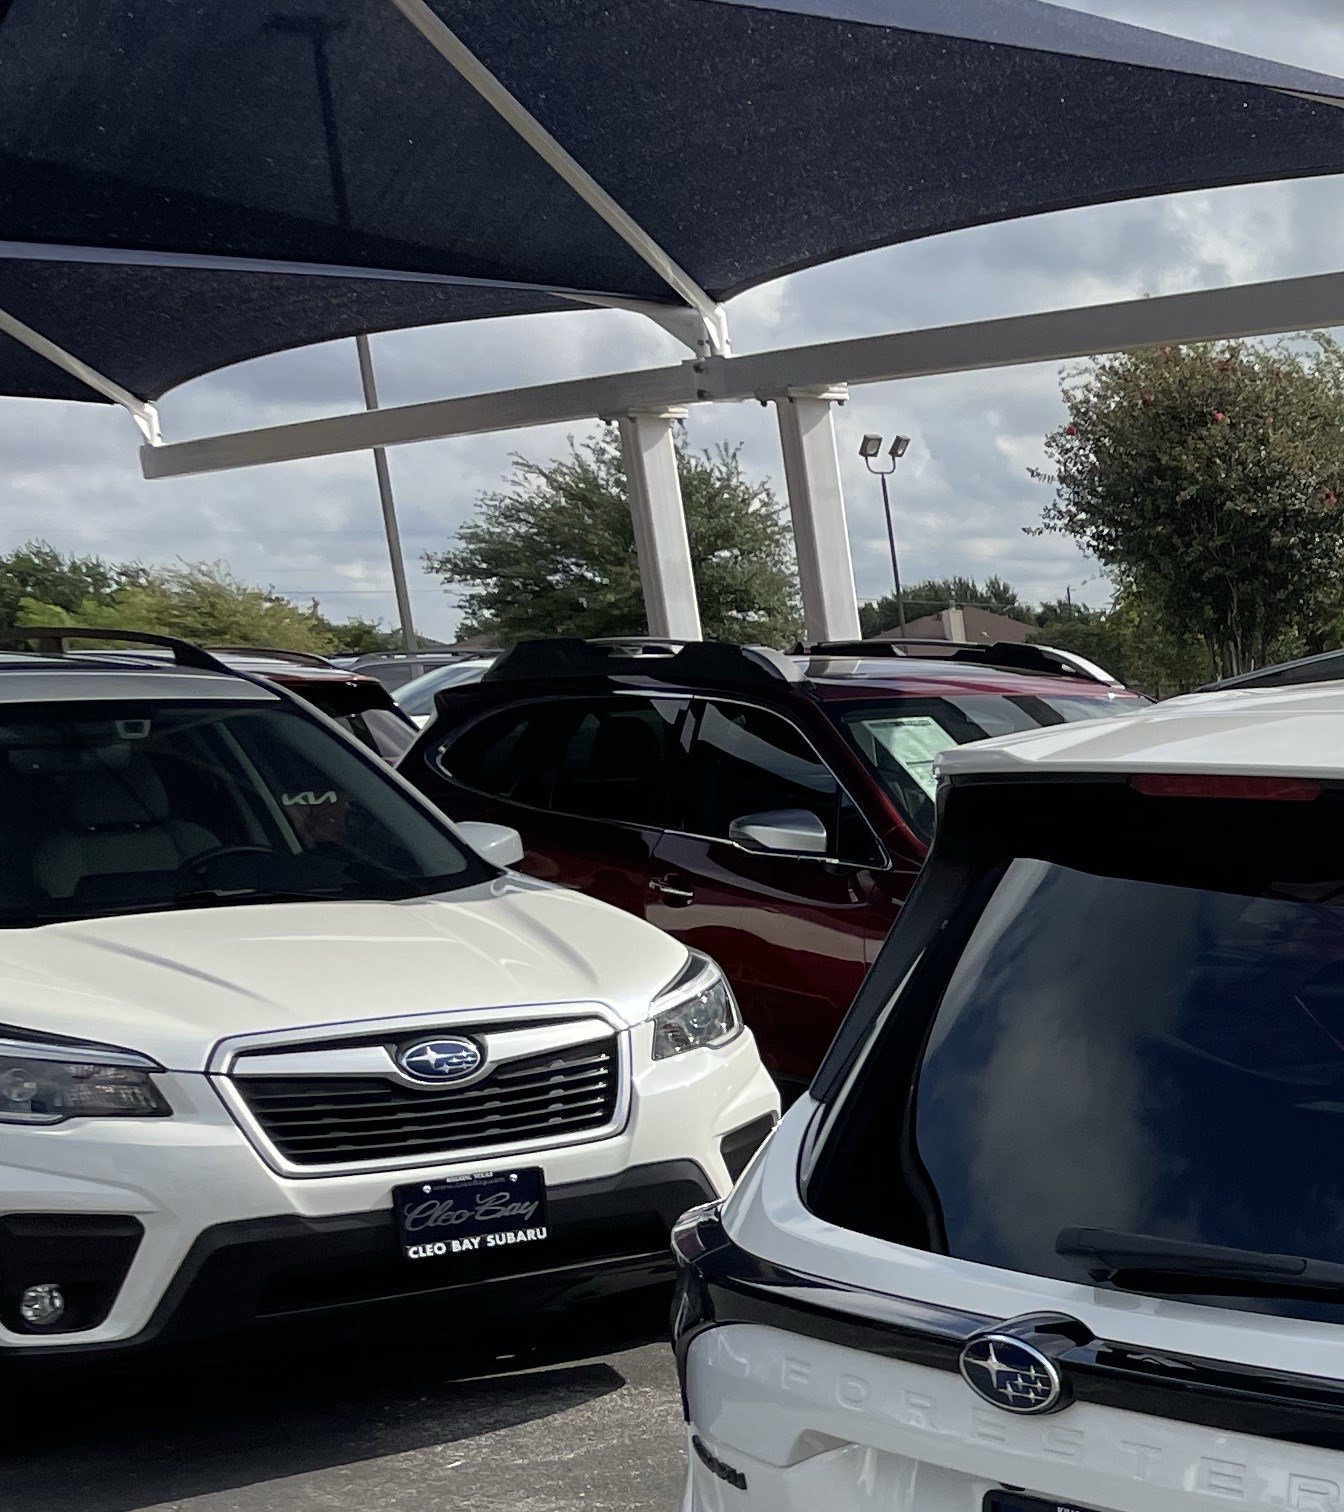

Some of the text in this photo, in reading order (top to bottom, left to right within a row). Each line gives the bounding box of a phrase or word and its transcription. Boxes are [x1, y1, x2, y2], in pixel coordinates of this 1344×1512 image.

[404, 1192, 540, 1231] Cleo Bay
[408, 1227, 547, 1259] CLEO BAY SUBARU
